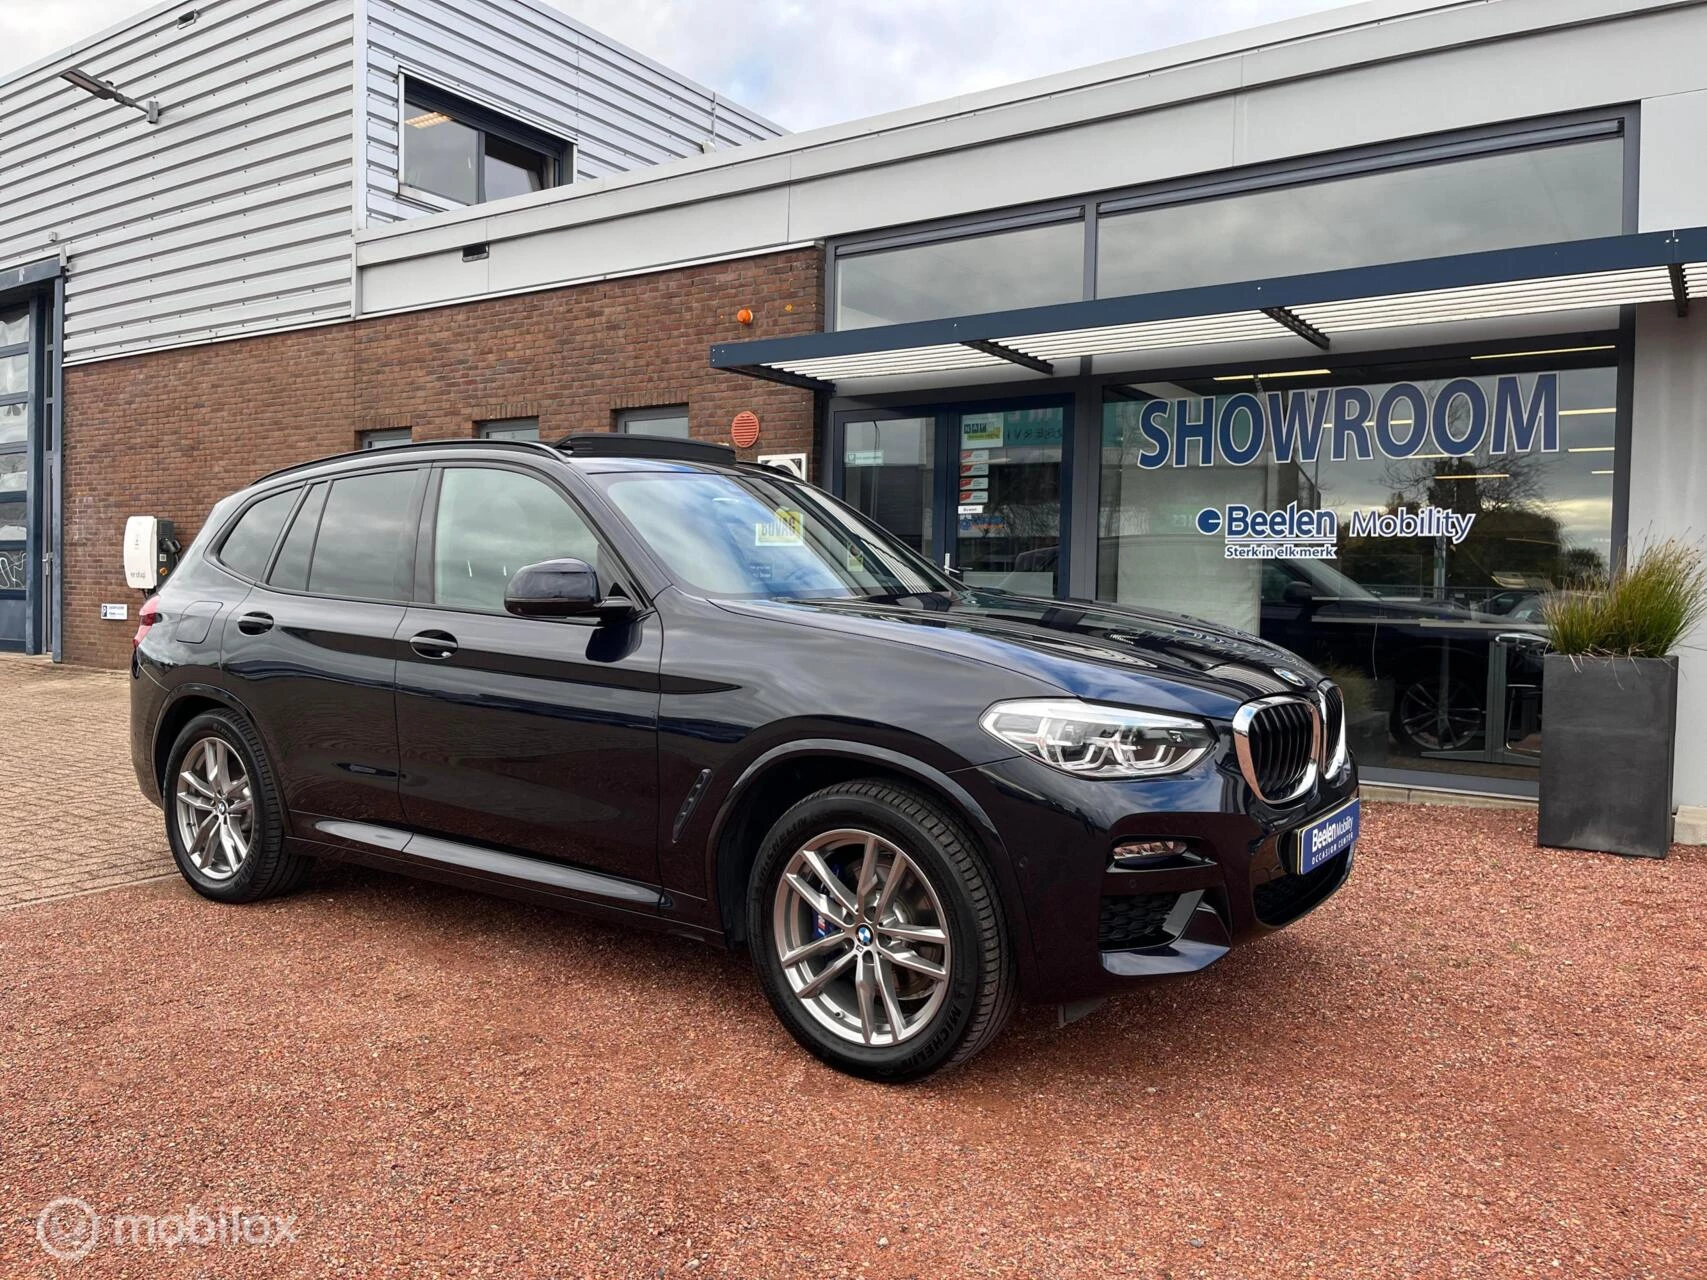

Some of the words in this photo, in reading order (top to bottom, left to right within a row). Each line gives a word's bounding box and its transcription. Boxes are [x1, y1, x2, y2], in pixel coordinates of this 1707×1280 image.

[1137, 372, 1560, 470] SHOWROOM
[1225, 500, 1337, 538] Beelen
[1349, 506, 1476, 544] Mobility
[1226, 545, 1260, 559] Sterk
[1261, 545, 1275, 559] in
[1277, 545, 1297, 559] elk
[1299, 545, 1337, 559] merk
[1312, 822, 1337, 853] Beelen
[1337, 816, 1353, 836] Mobility
[1312, 844, 1337, 865] OCCASION
[1338, 832, 1353, 848] CENTER
[900, 1004, 962, 1067] MICHELIN
